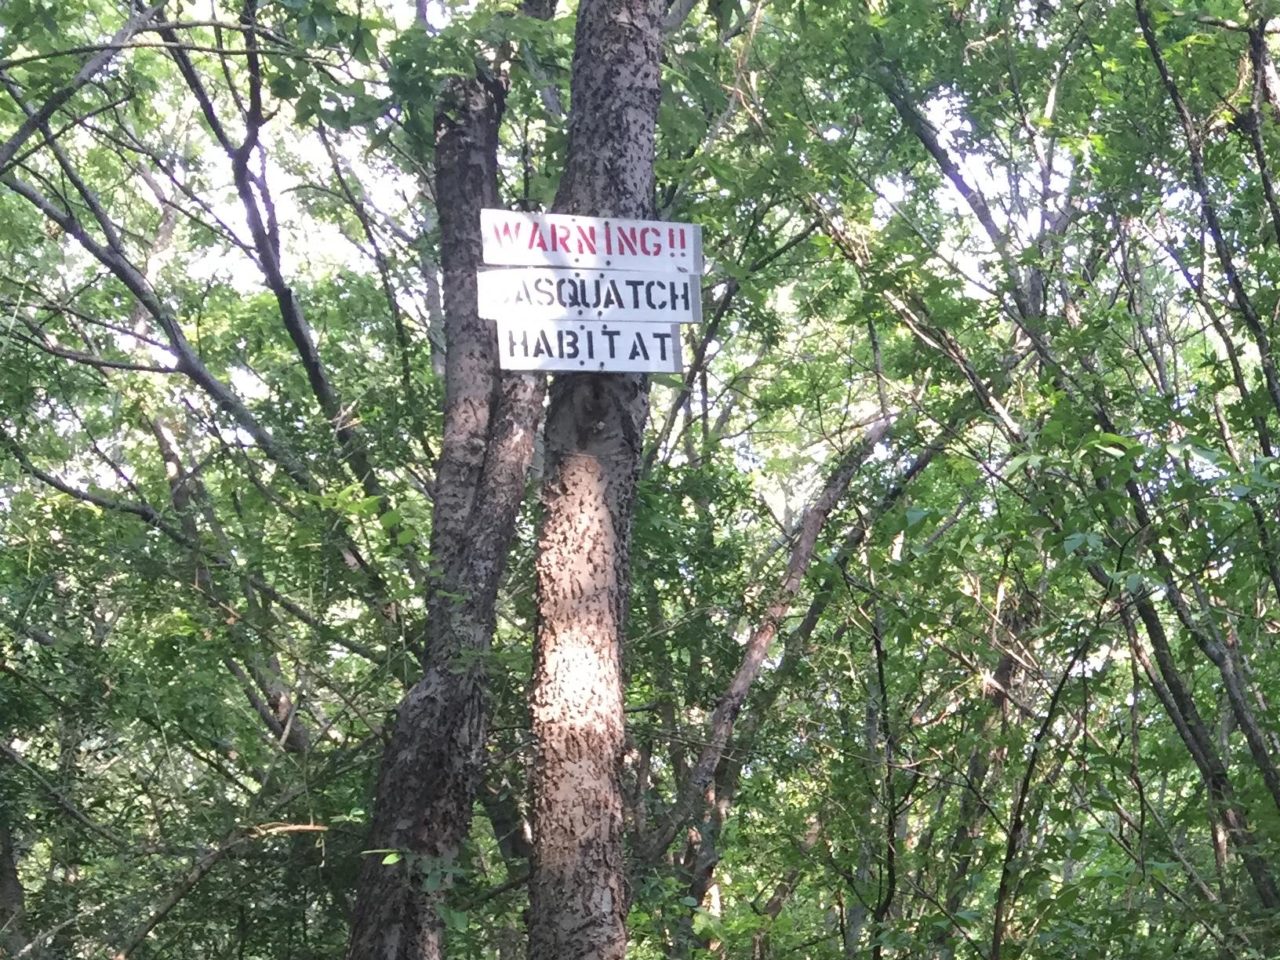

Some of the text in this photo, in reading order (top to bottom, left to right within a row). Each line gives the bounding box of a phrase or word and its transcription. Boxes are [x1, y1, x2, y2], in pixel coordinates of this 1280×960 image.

[493, 222, 687, 258] WARNING!!
[496, 278, 690, 311] ASQUATCH
[508, 329, 672, 361] HABITAT
